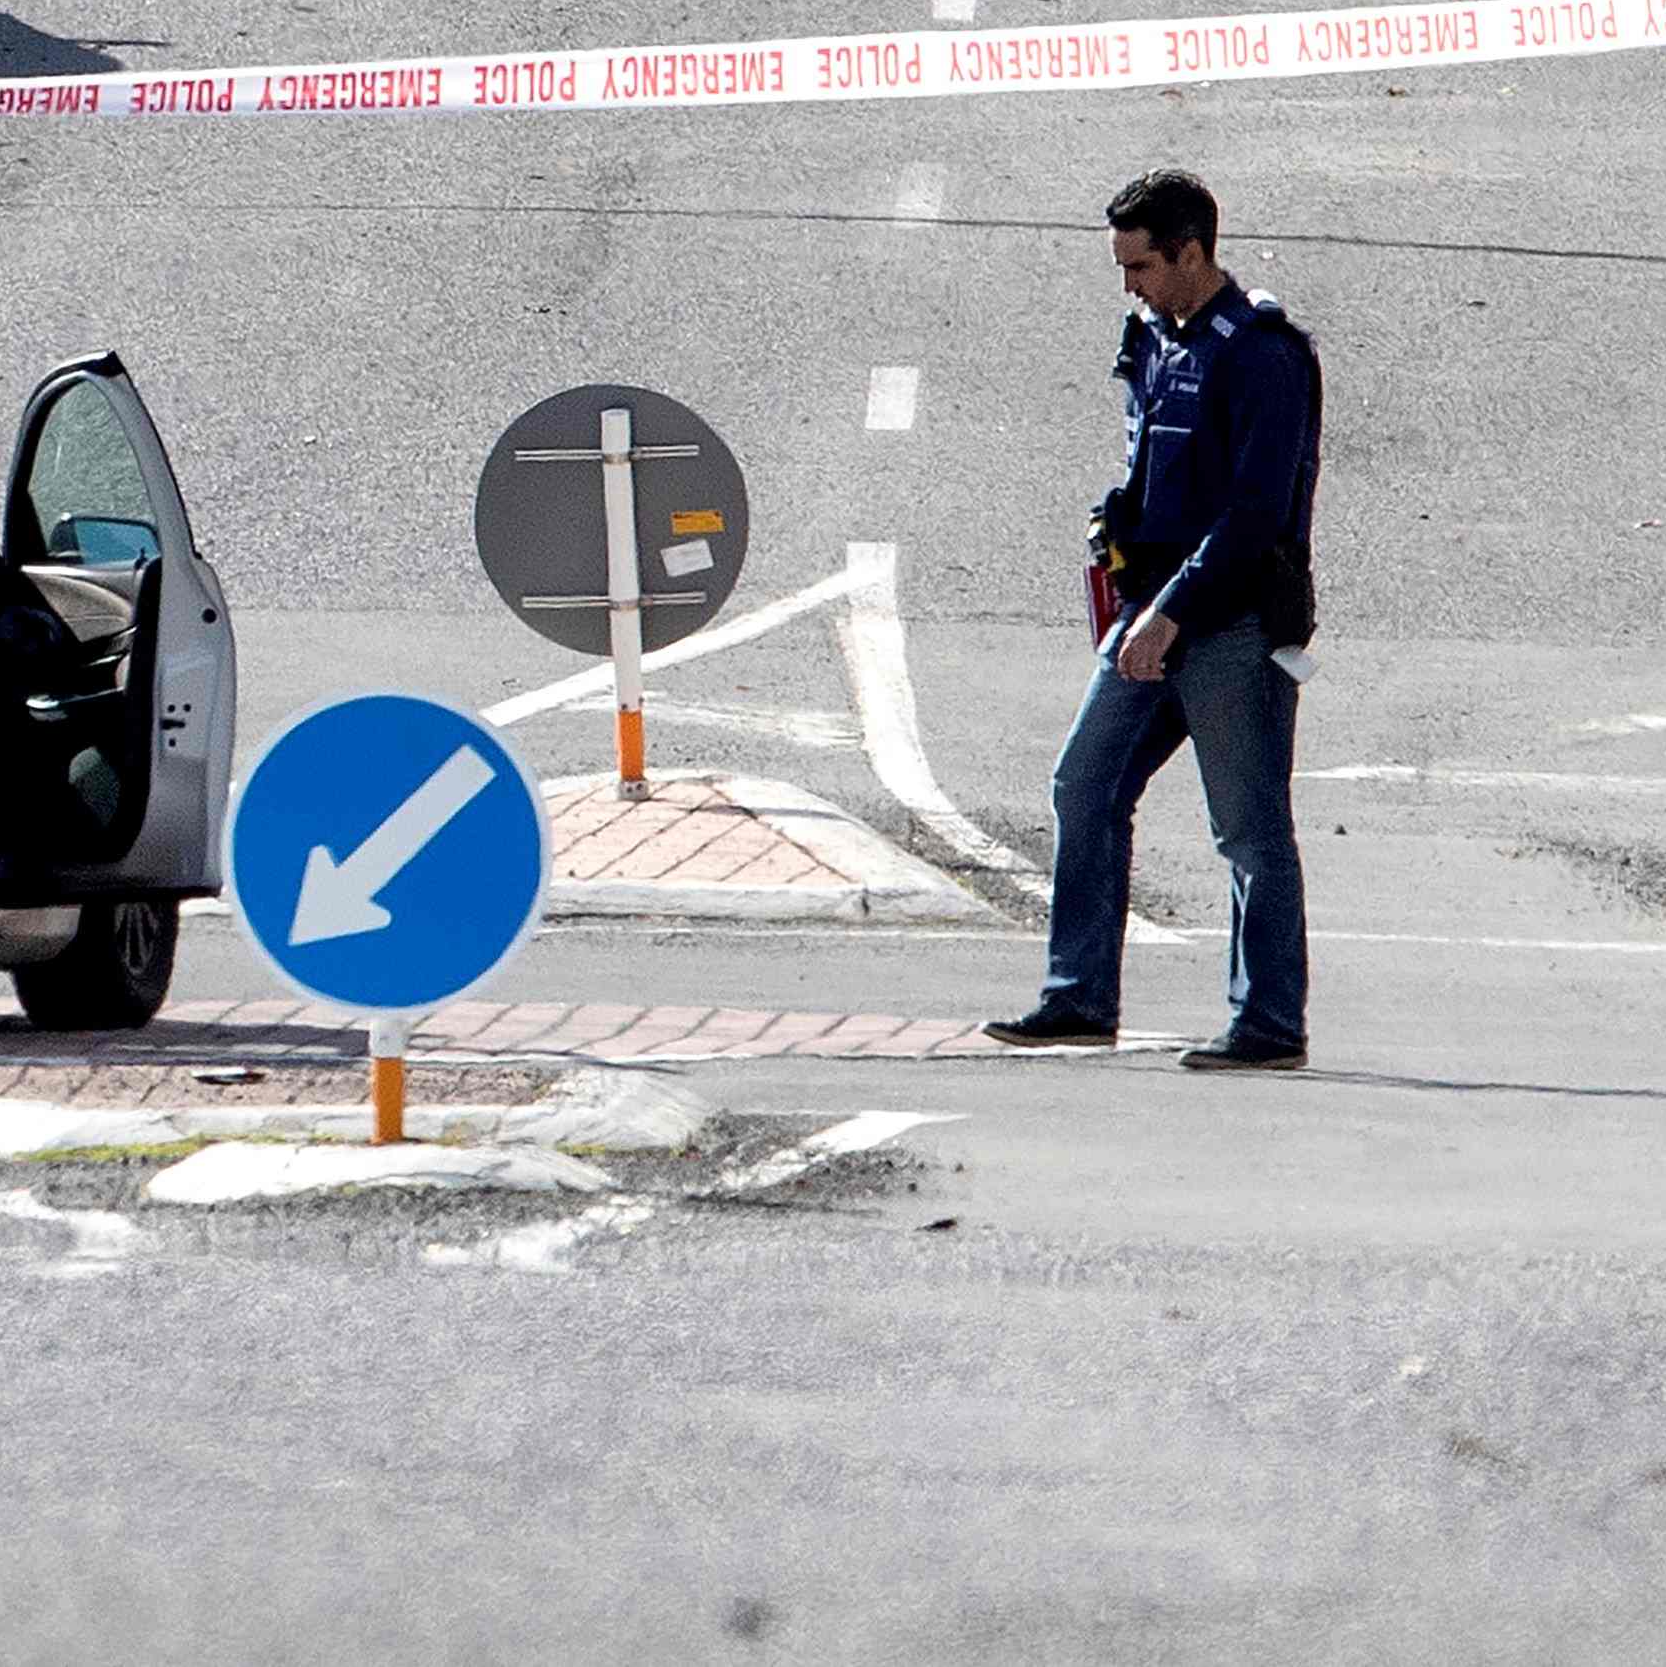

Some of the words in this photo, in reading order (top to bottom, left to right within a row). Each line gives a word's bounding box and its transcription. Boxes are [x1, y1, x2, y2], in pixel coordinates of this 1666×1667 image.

[950, 34, 1132, 83] EMERGENCY
[1164, 24, 1270, 73] POLICE
[1298, 9, 1479, 63] EMERGENCY
[258, 67, 444, 111] EMERGENCY
[473, 61, 577, 106] POLICE
[601, 49, 785, 101] EMERGENCY
[816, 41, 922, 90] POLICE
[129, 77, 236, 114] POLICE
